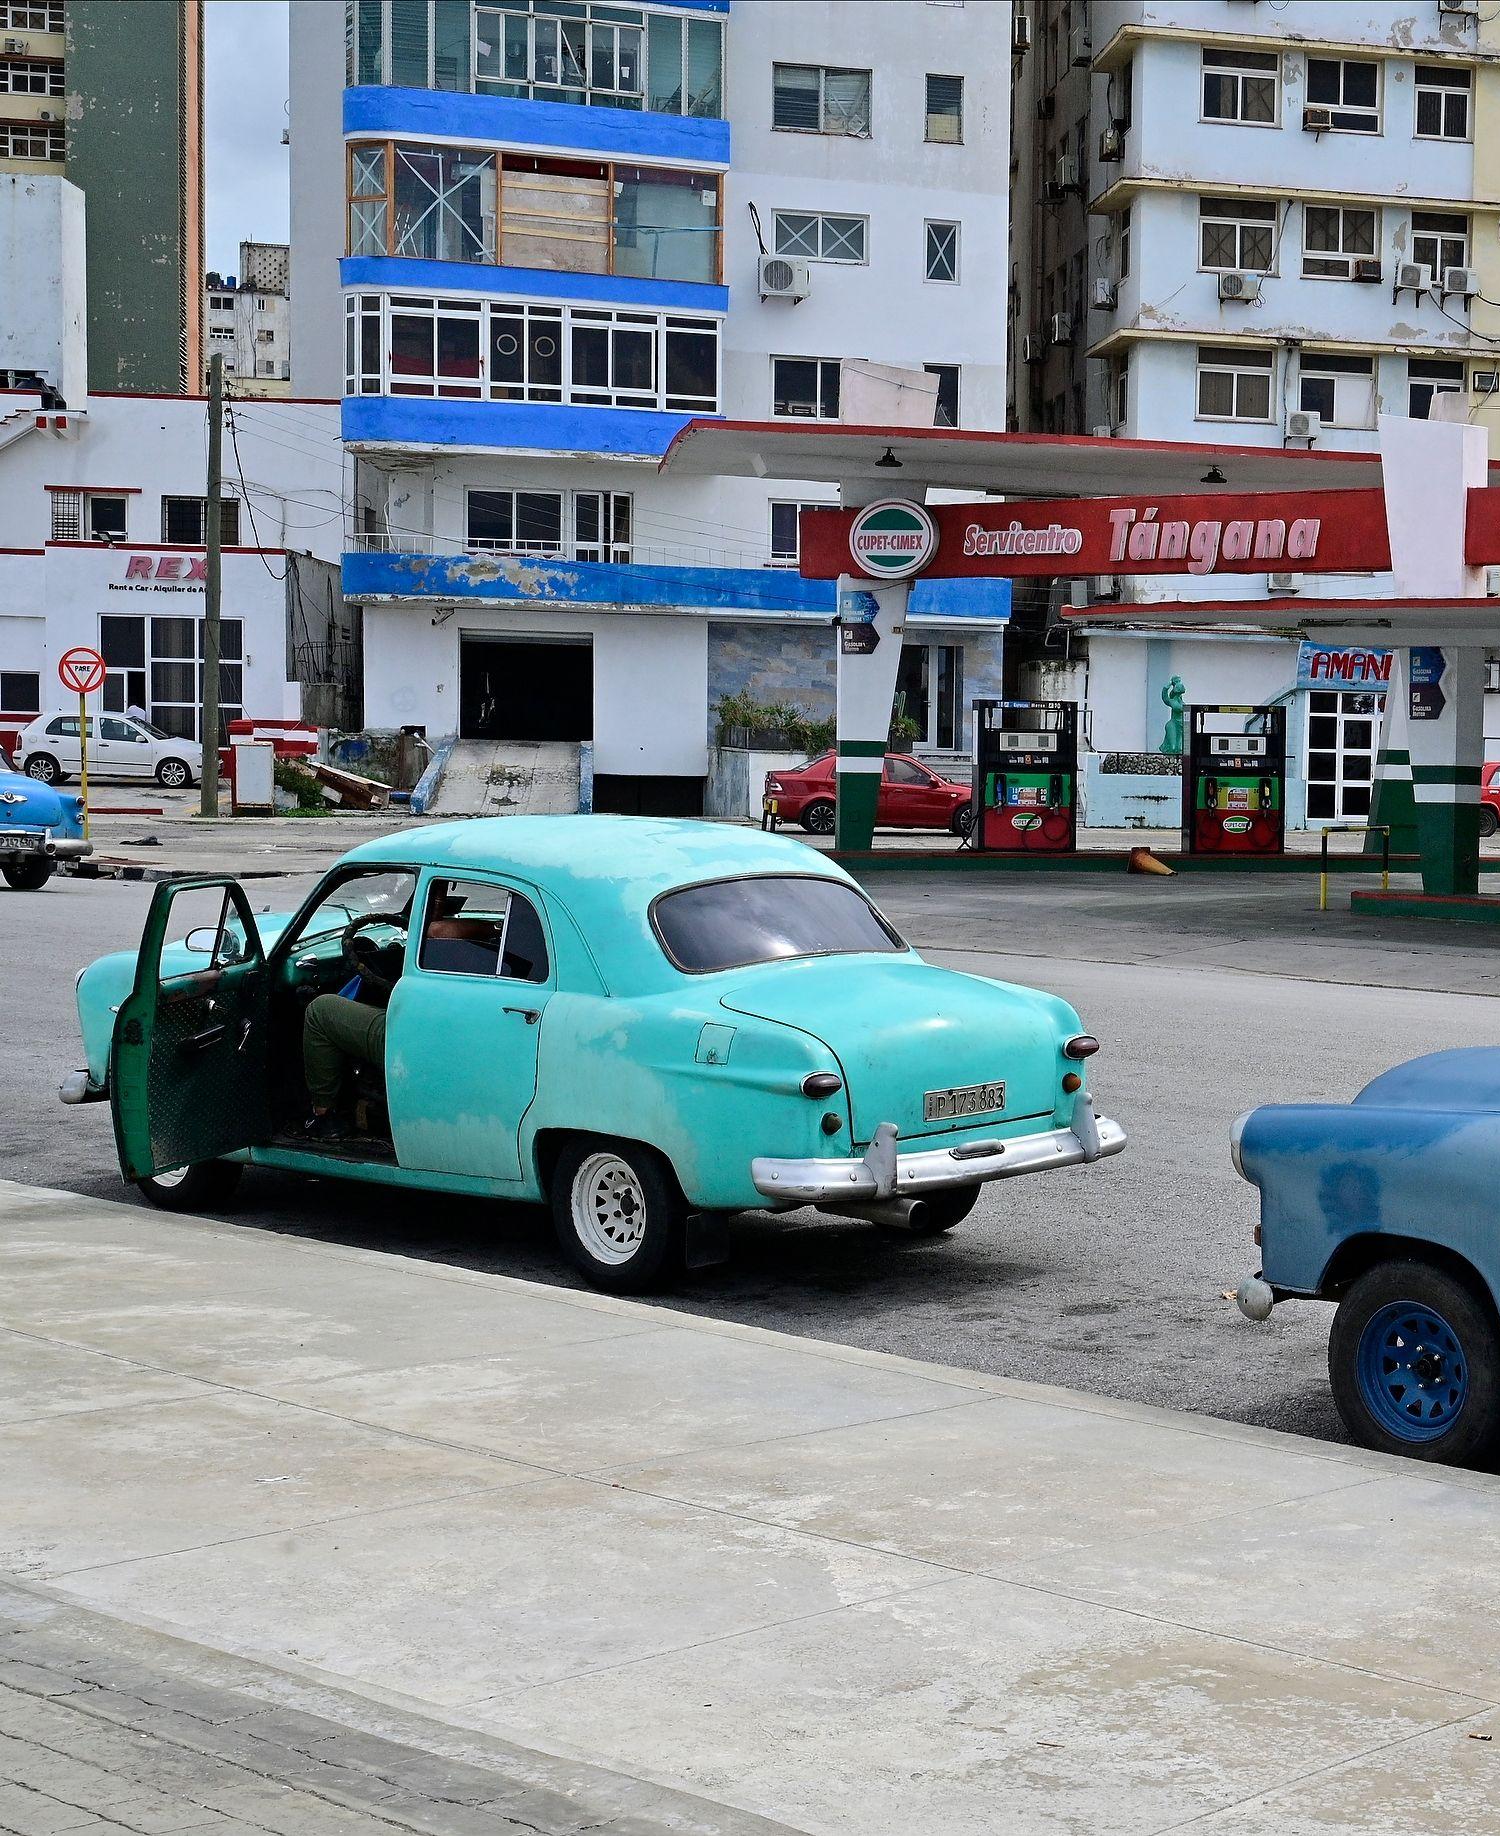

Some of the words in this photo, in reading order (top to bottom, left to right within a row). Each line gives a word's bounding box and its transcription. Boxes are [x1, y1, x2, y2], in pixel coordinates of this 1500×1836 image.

[857, 534, 923, 550] CUPET-CIMEX
[963, 521, 1082, 555] Servicentro
[1109, 507, 1321, 575] Tángana
[126, 556, 207, 580] REX
[135, 584, 149, 592] Car
[153, 585, 185, 594] Alquiler
